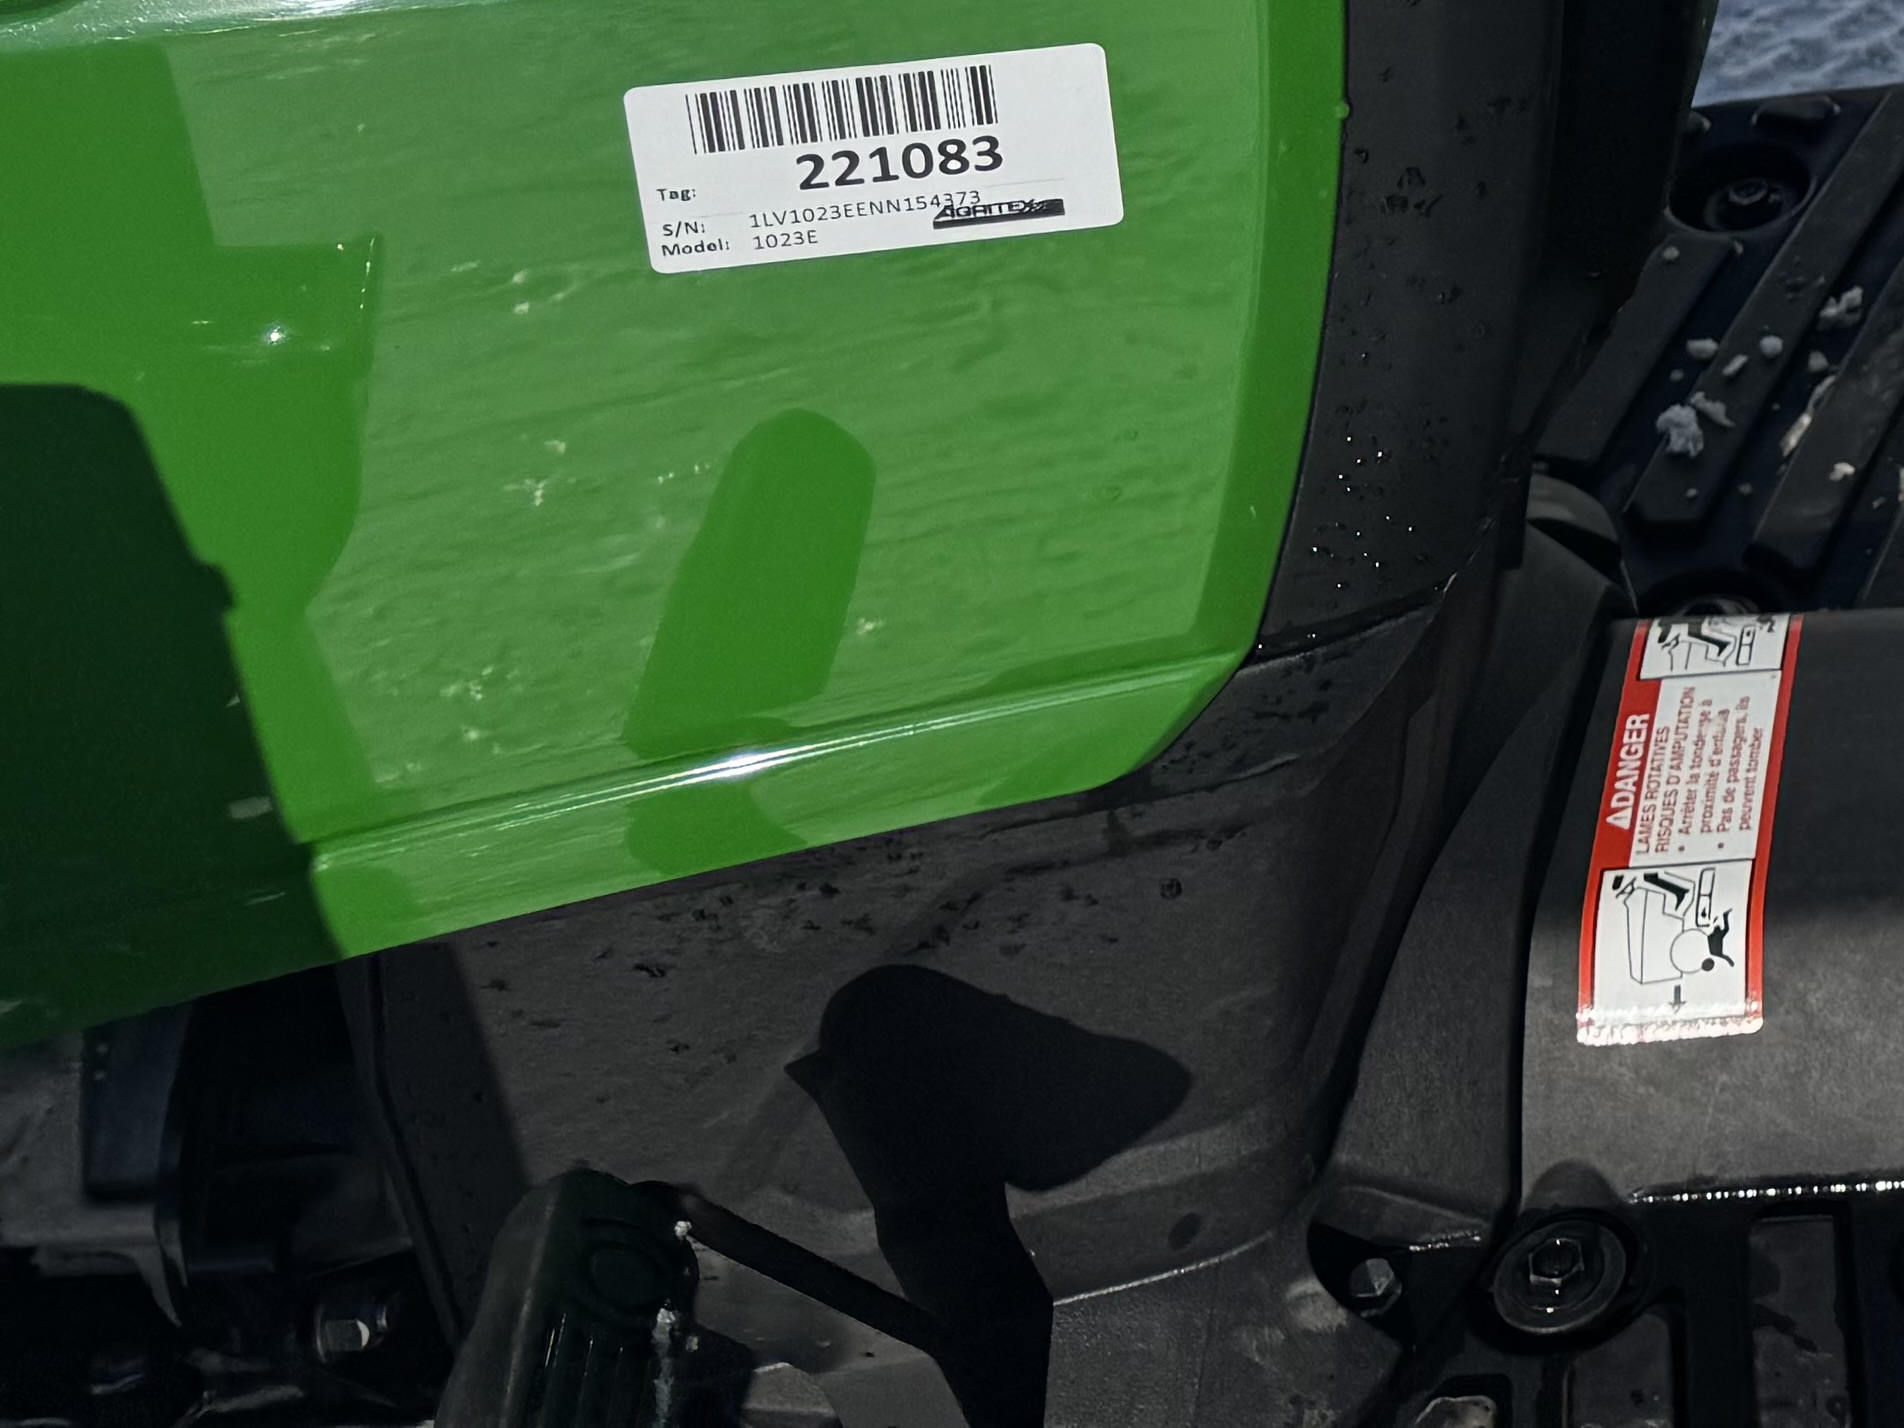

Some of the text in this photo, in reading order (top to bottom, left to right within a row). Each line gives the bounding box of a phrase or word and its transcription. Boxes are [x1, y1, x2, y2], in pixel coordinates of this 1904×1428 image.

[796, 134, 1004, 191] 221083
[657, 187, 697, 203] Tag:
[662, 189, 982, 238] S/N: 1LV1023EENN154373
[661, 229, 819, 258] Model: 1023E
[1698, 699, 1712, 707] à
[1736, 696, 1750, 710] ils
[1610, 714, 1650, 808] DANGER
[1655, 687, 1695, 853] RISQUES D'AMPUTATION
[1686, 773, 1700, 784] la
[1738, 728, 1762, 830] peuvent tomber
[1637, 726, 1670, 854] LAMES ROTATIVES
[1679, 789, 1695, 835] Arrêter
[1700, 771, 1719, 833] proximité
[1722, 787, 1735, 803] de
[1717, 807, 1731, 832] Pas
